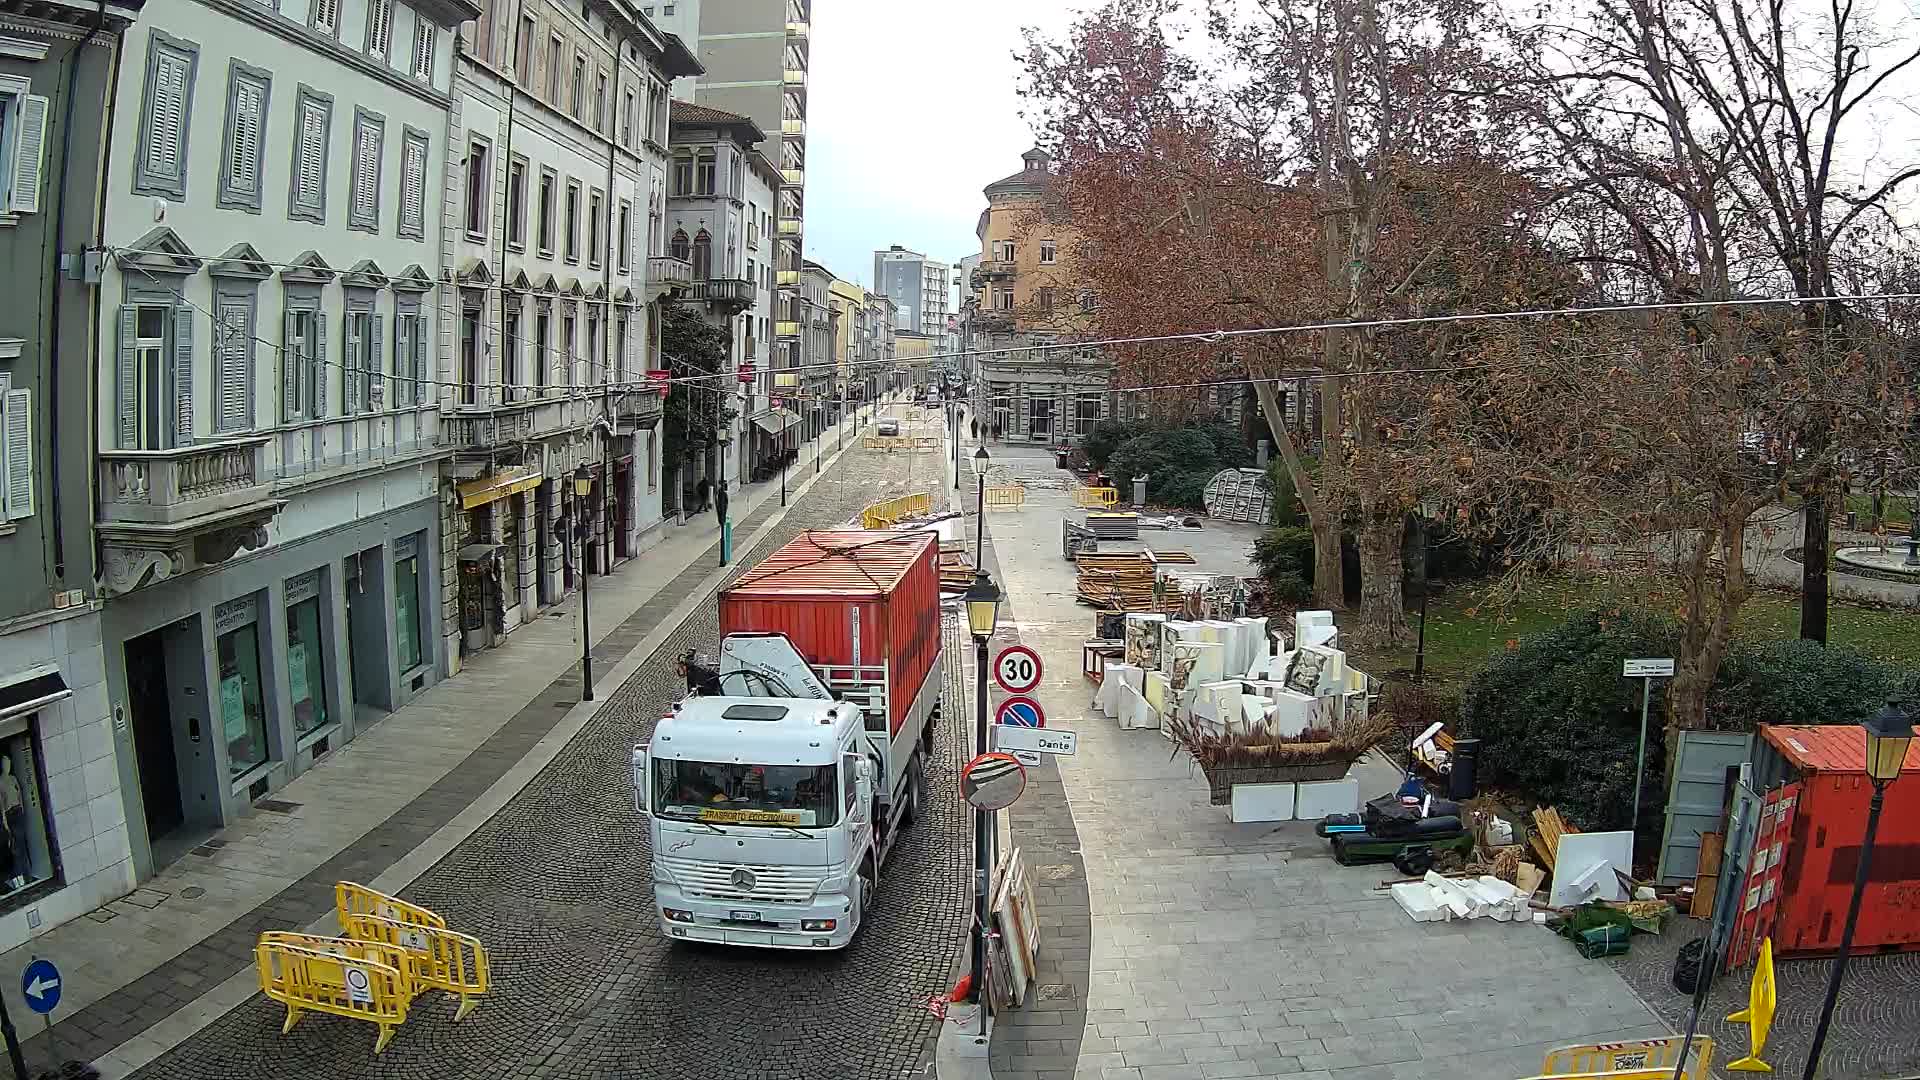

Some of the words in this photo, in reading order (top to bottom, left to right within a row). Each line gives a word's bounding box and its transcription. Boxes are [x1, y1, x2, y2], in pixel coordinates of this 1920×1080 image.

[1005, 659, 1032, 681] 30
[1039, 738, 1070, 750] Dante
[705, 810, 746, 822] TRASPORTO
